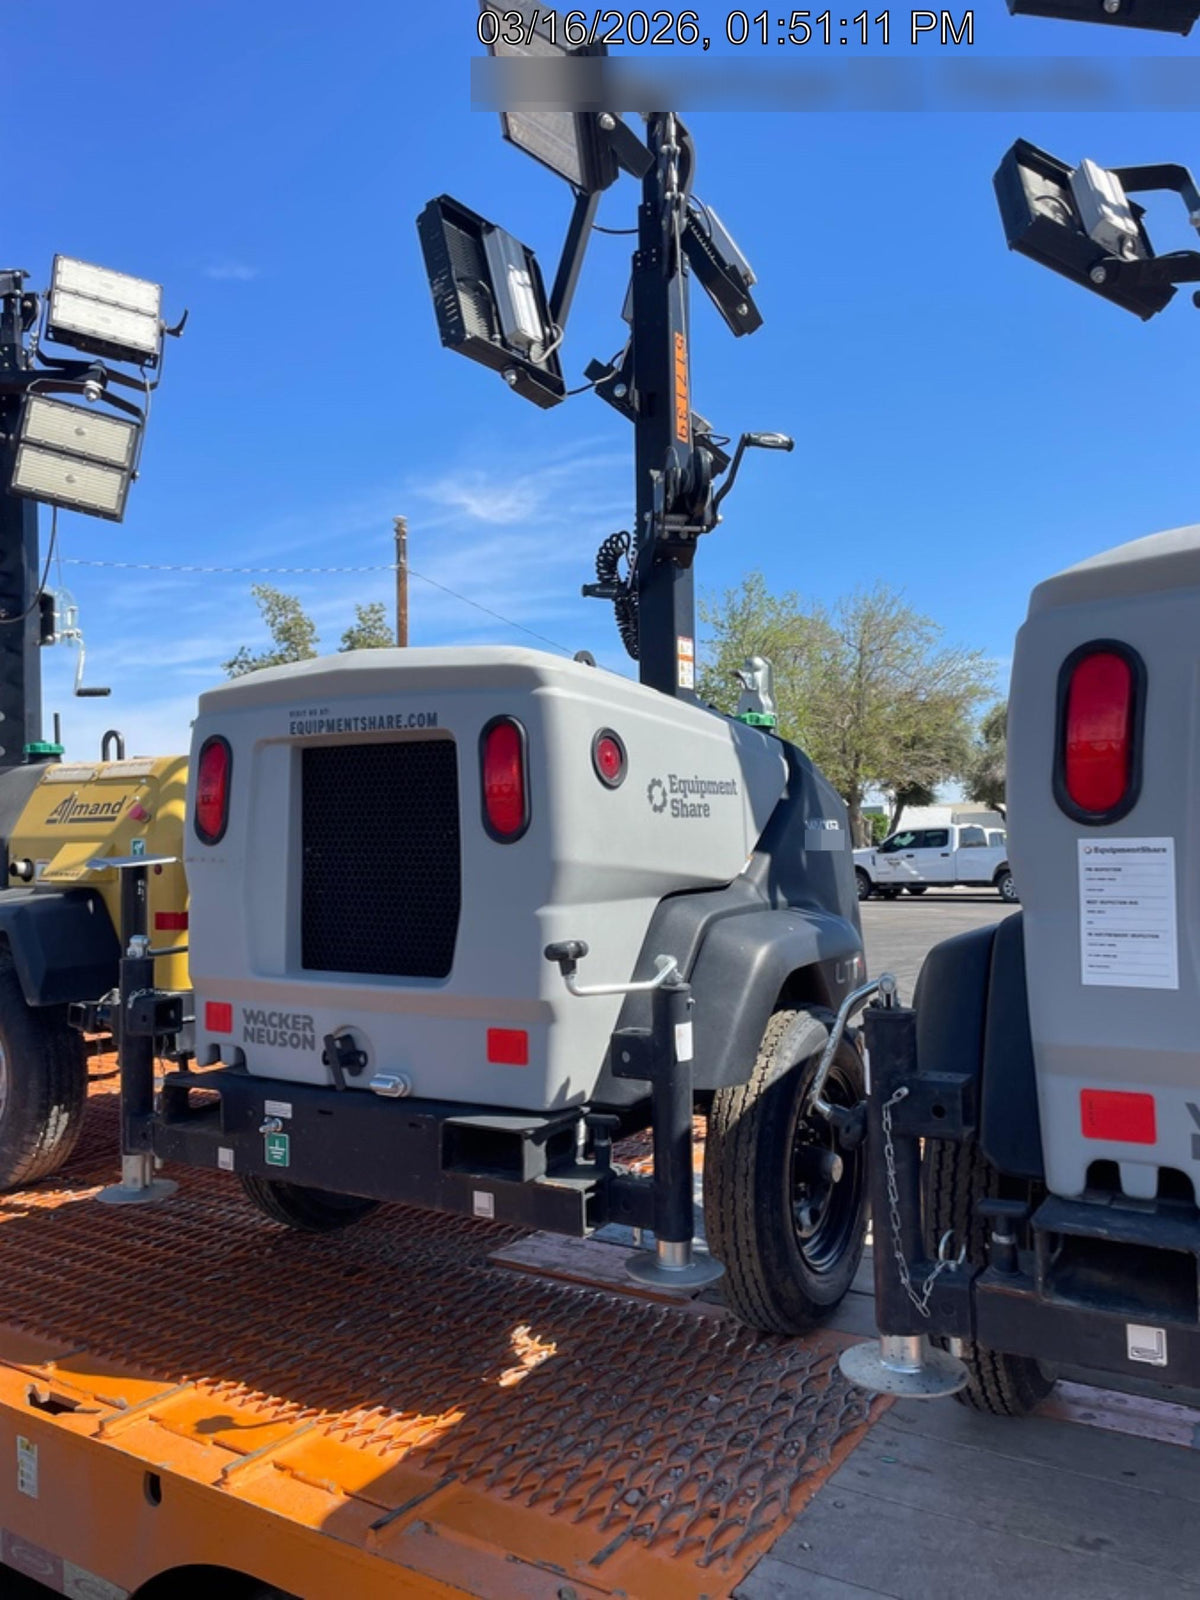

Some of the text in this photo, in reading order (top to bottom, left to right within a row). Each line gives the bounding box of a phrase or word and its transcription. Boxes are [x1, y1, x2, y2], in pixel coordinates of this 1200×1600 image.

[289, 711, 438, 735] EQUIPMENTSHARE.COM
[667, 773, 738, 799] Equipment
[46, 791, 127, 824] Allmand
[670, 798, 711, 818] Share
[242, 1007, 315, 1034] WACKER
[242, 1026, 316, 1051] NEUSON
